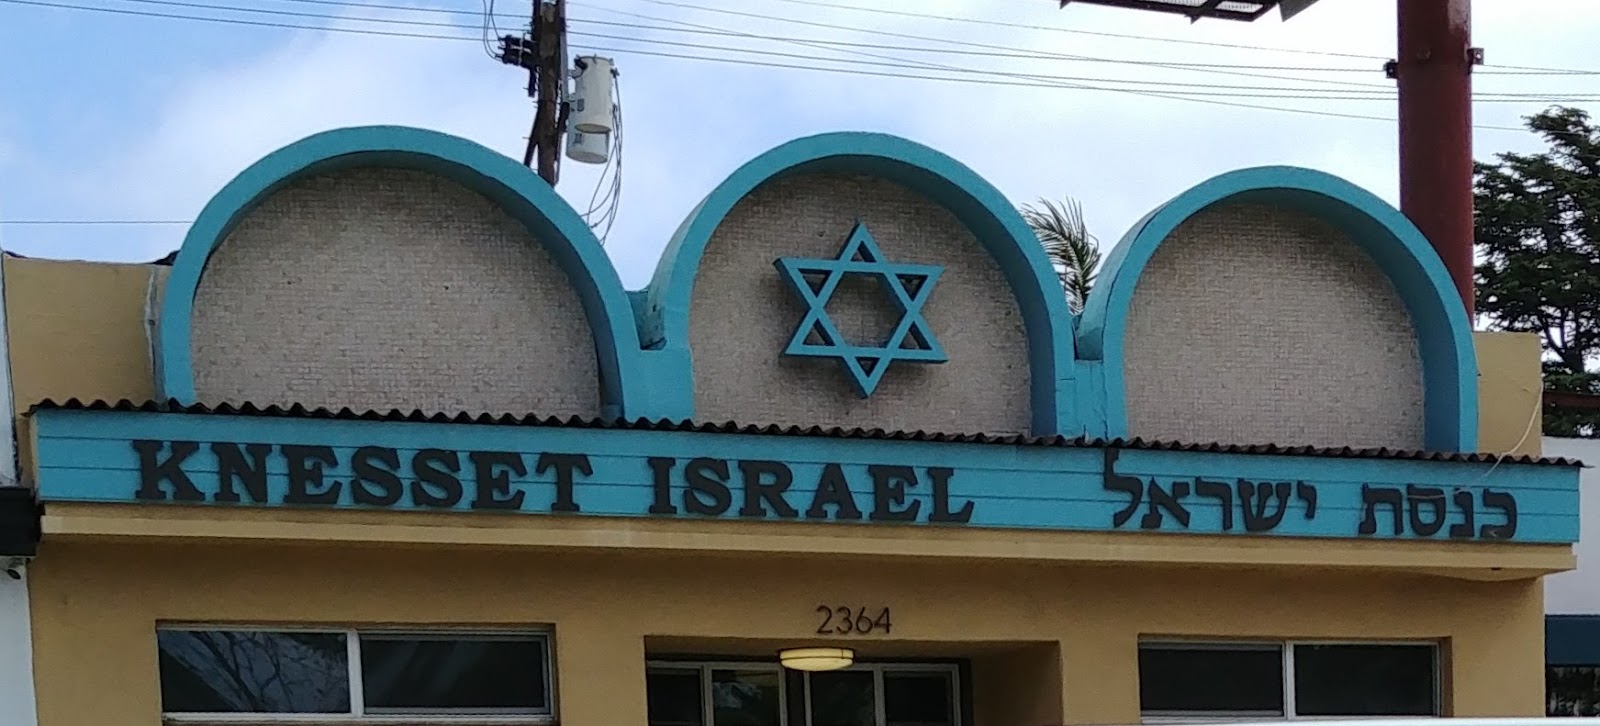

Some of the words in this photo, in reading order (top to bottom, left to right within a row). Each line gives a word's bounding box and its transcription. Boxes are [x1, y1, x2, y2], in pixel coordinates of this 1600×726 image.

[133, 440, 593, 513] KNESSET
[648, 457, 975, 524] ISRAEL
[1103, 449, 1317, 532] ישראל
[1359, 483, 1518, 539] כנסת
[816, 605, 893, 634] 2364
